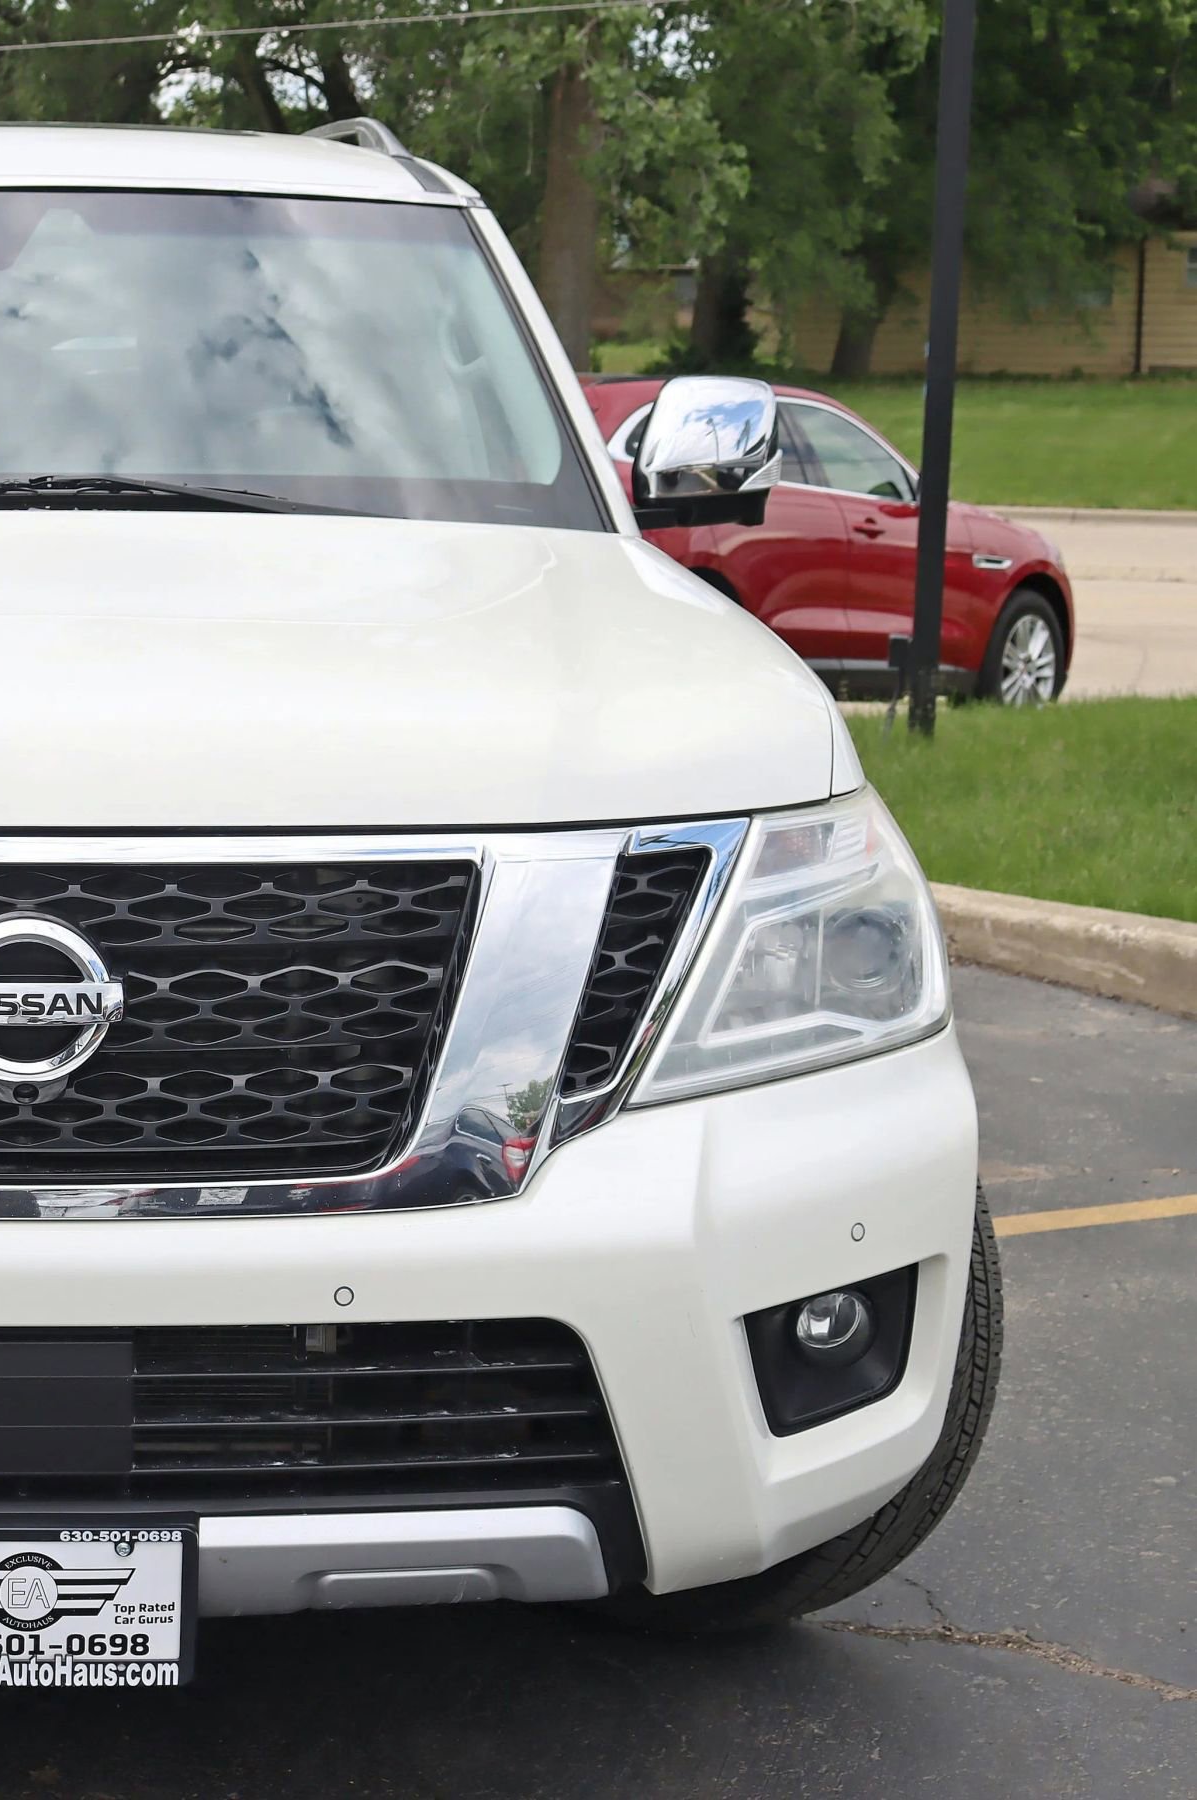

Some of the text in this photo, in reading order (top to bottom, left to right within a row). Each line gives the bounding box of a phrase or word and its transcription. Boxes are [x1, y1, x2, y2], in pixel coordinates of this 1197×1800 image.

[59, 1530, 182, 1542] 630-501-0698
[4, 1555, 53, 1570] EXCLUSIVE
[7, 1578, 50, 1608] EA
[113, 1602, 175, 1615] Top Rated
[2, 1615, 55, 1629] AUTOHAUS
[114, 1615, 174, 1624] Car Gurus
